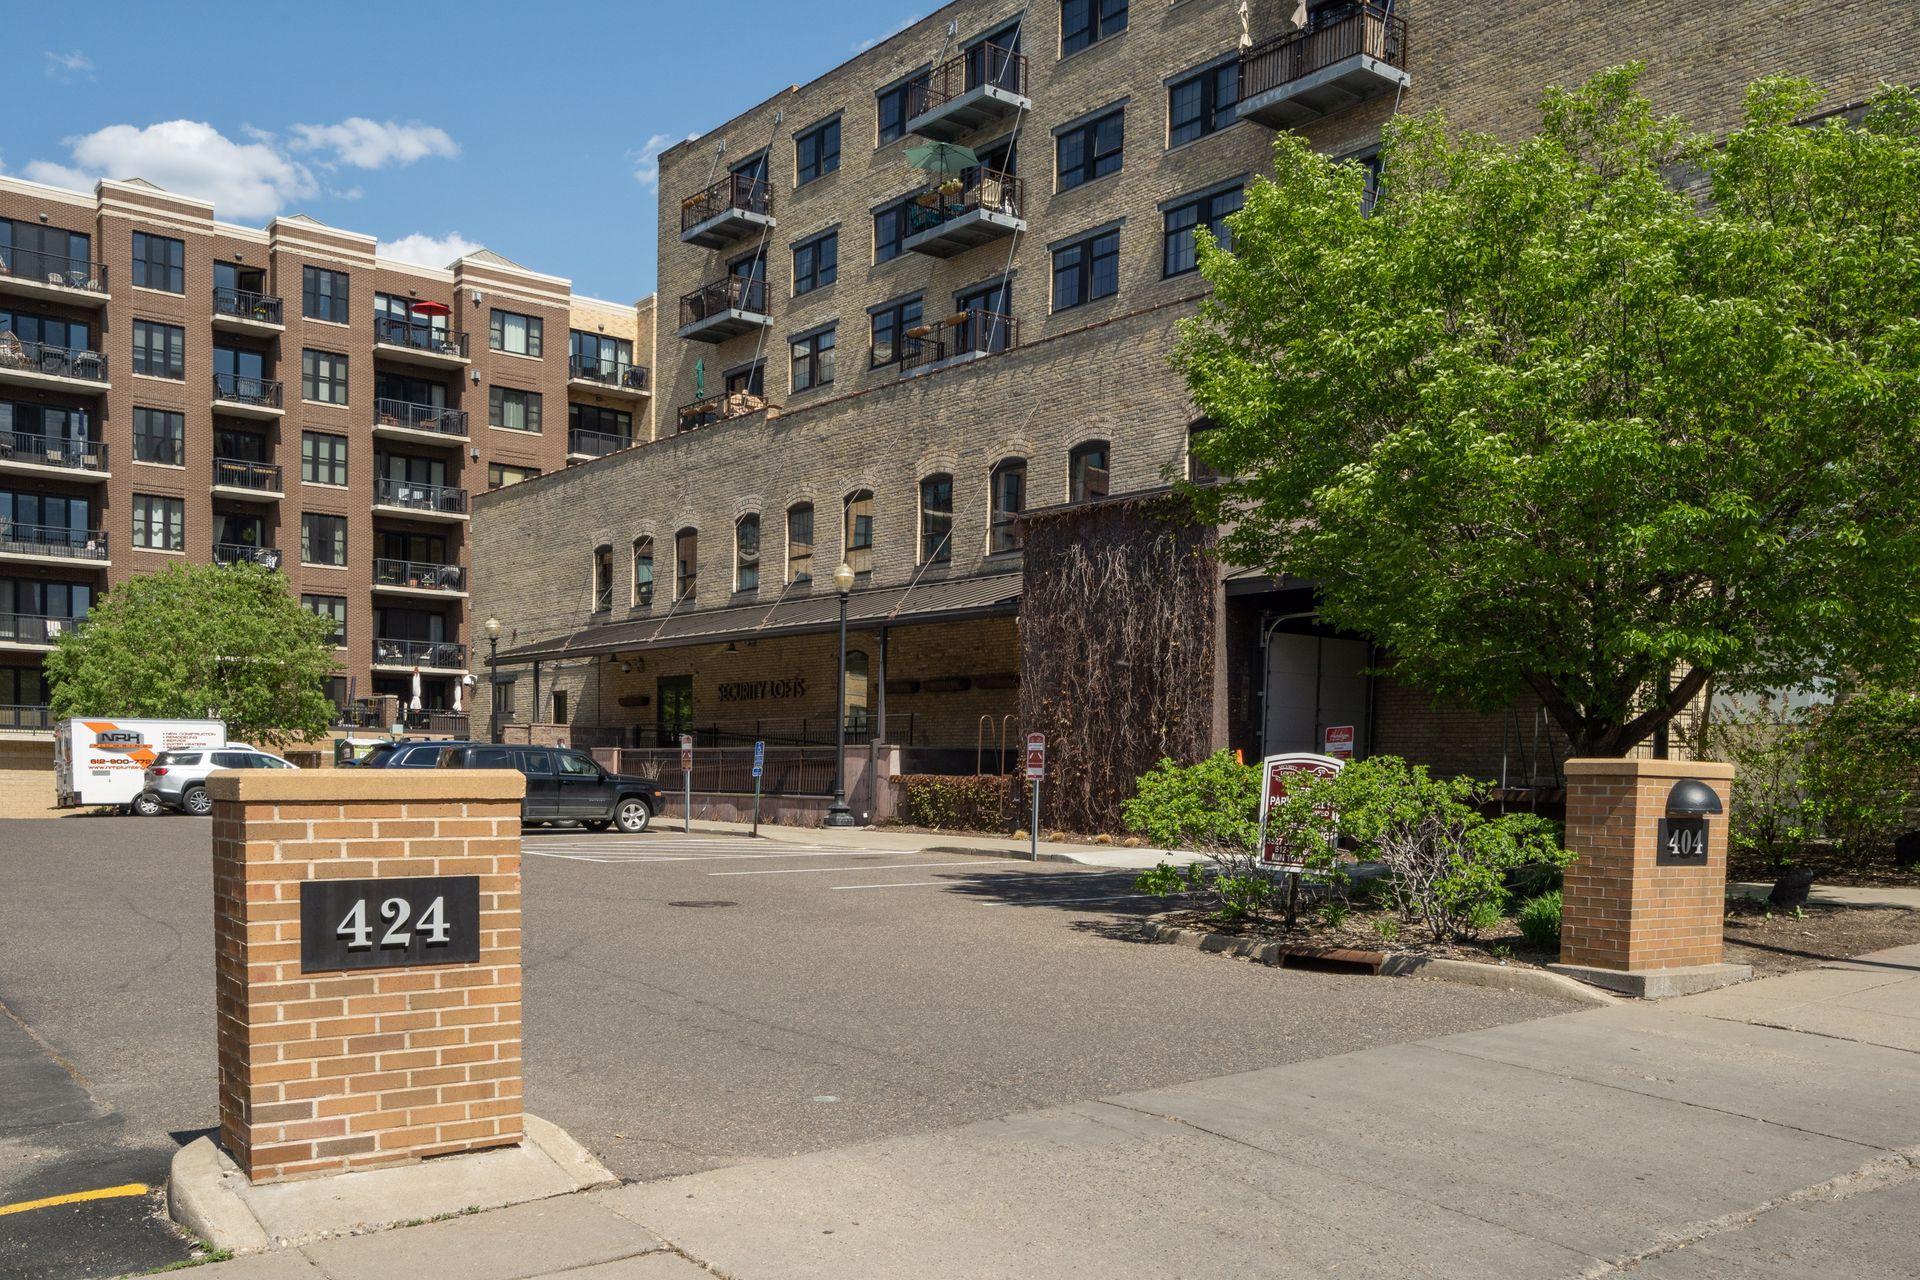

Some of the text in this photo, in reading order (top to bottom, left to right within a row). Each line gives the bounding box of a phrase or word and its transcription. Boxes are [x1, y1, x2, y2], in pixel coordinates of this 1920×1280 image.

[719, 677, 806, 701] SECURITY LOFTS
[102, 733, 140, 743] NRH
[1667, 829, 1703, 854] 404
[336, 896, 450, 948] 424
